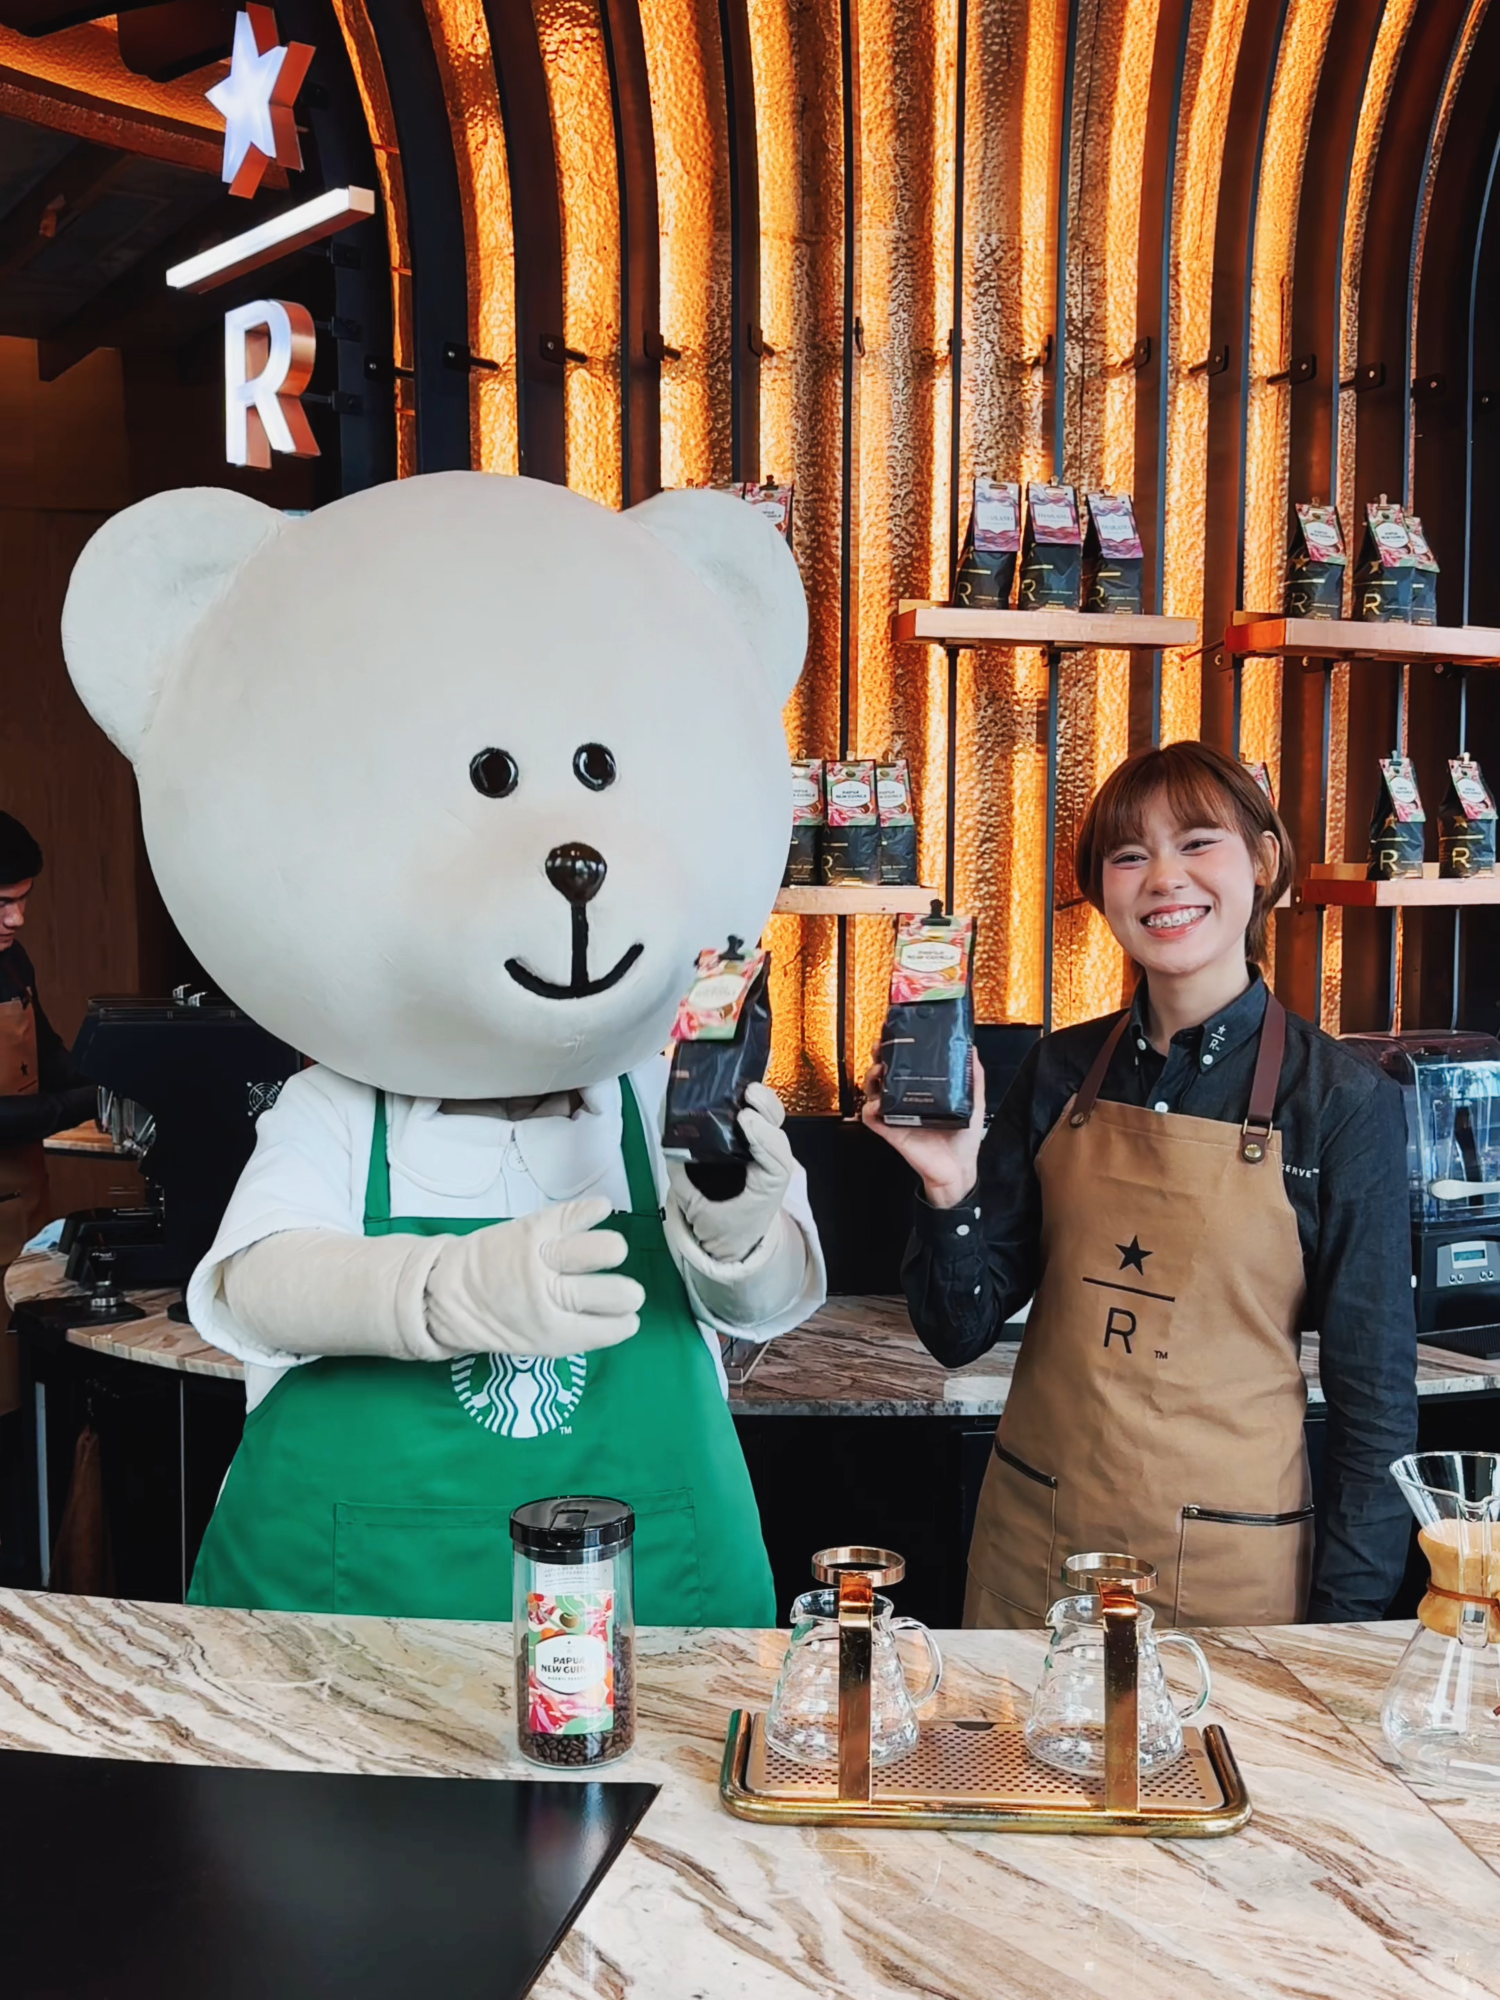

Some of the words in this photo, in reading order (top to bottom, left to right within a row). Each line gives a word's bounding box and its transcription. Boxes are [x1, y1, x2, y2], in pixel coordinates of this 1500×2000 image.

[225, 299, 321, 469] R
[1363, 593, 1381, 615] R
[1380, 849, 1399, 871] R
[1452, 847, 1471, 868] R
[1103, 1306, 1138, 1354] R
[541, 1664, 561, 1673] NEW
[563, 1665, 593, 1674] GUIN
[553, 1656, 585, 1665] PAPUA
